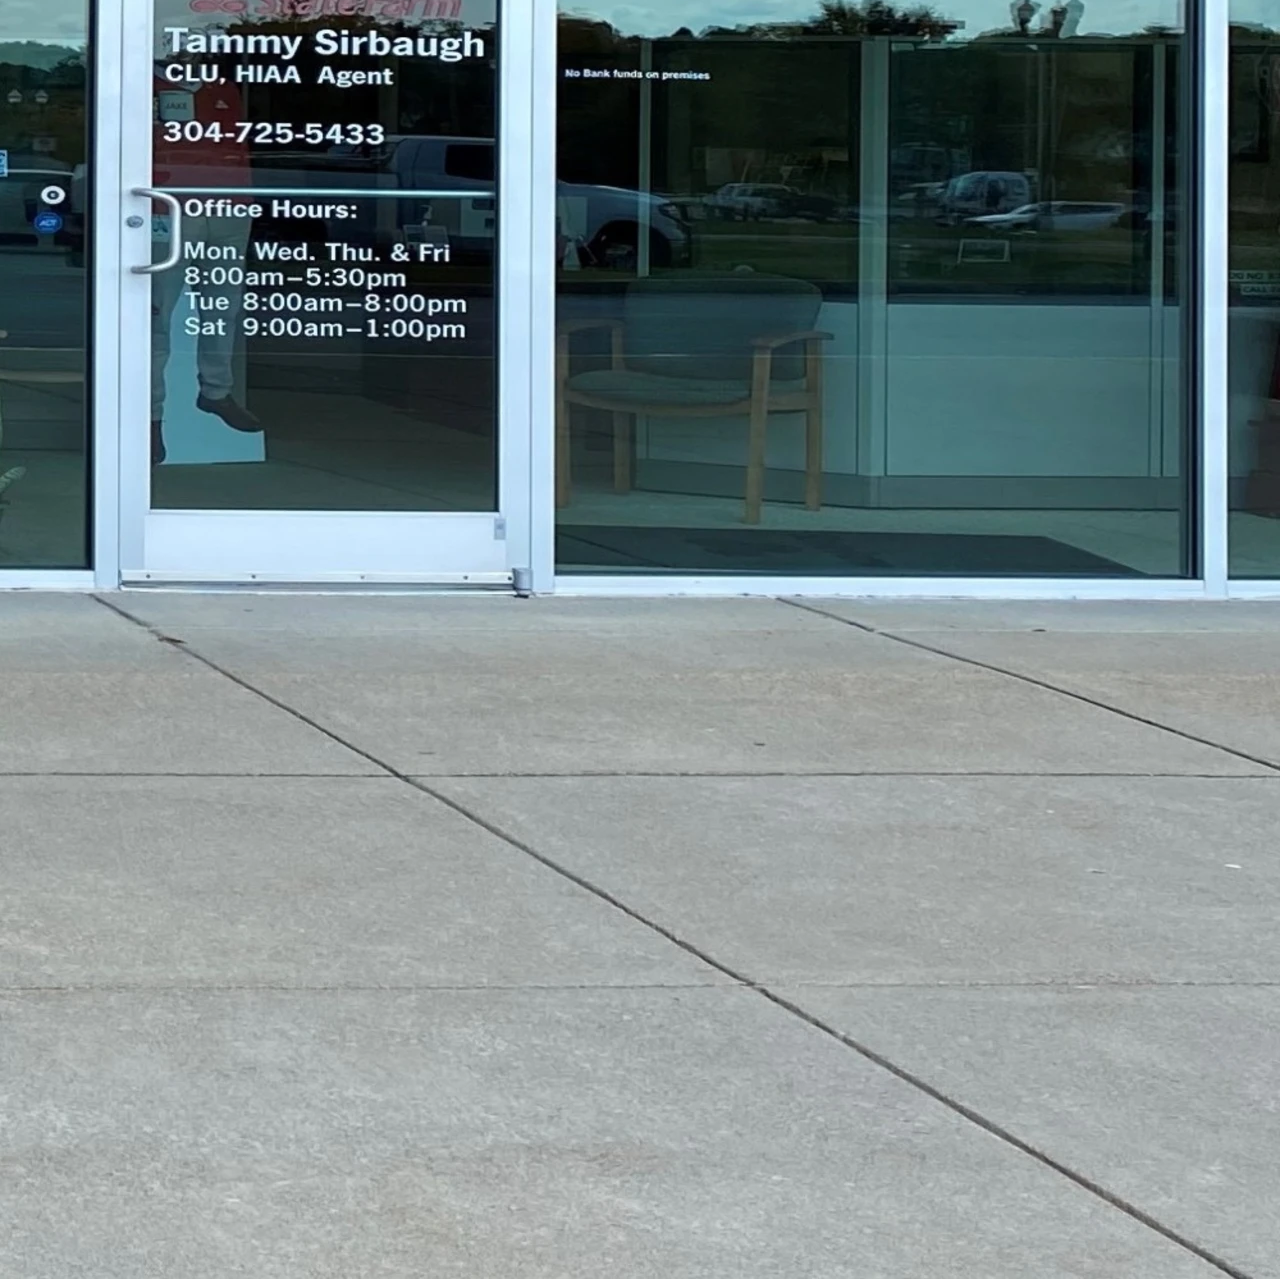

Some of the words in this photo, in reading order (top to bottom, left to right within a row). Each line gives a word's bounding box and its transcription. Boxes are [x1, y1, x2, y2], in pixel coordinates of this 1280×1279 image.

[163, 26, 303, 60] Tammy
[314, 28, 485, 62] Sirbaugh
[164, 63, 227, 85] CLU,
[235, 64, 302, 84] HIAA
[317, 65, 395, 88] Agent
[564, 68, 581, 78] No
[583, 68, 611, 78] Bank
[612, 69, 643, 79] funds
[645, 71, 659, 80] on
[661, 70, 712, 81] premises
[163, 121, 386, 146] 304-725-5433
[184, 198, 263, 219] Office
[271, 199, 358, 220] Hours:
[184, 241, 245, 262] Mon.
[254, 242, 316, 262] Wed.
[325, 242, 381, 263] Thu.
[390, 243, 411, 262] &
[418, 243, 451, 263] Fri
[184, 292, 230, 311] Tue
[184, 317, 227, 337] Sat
